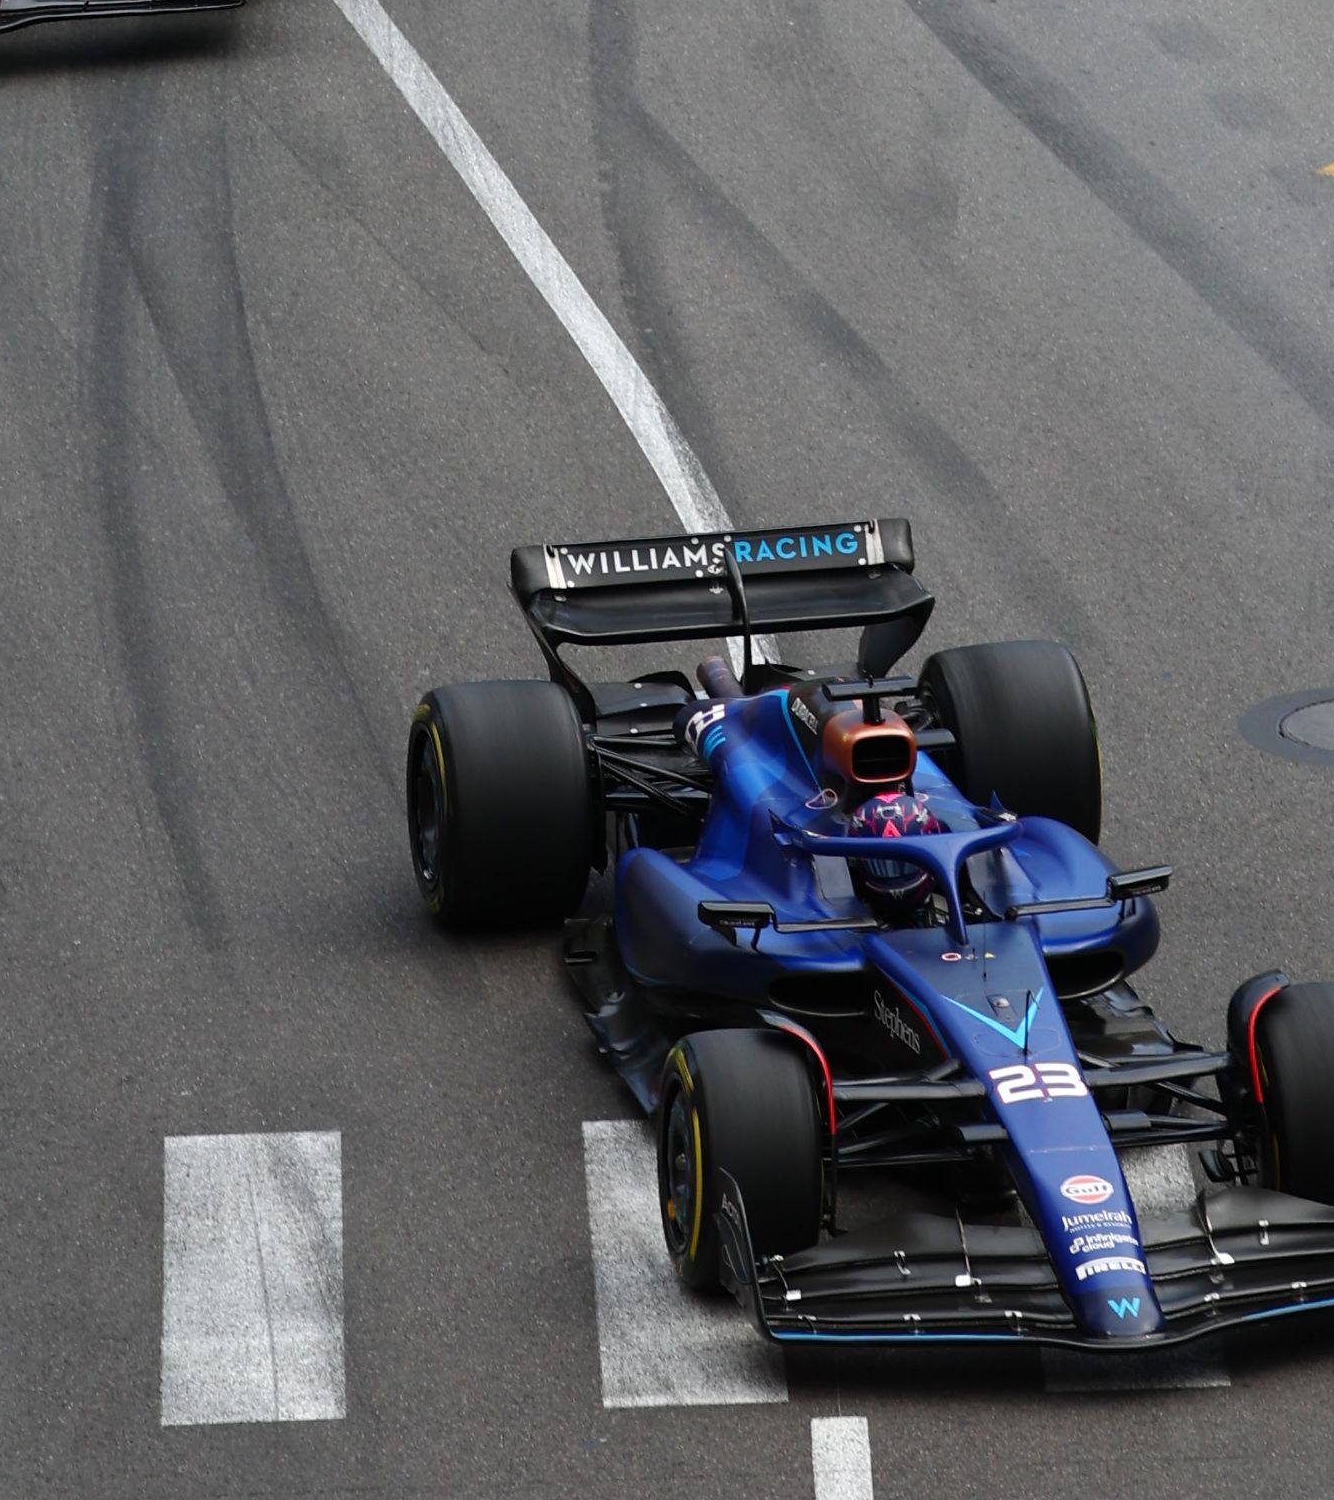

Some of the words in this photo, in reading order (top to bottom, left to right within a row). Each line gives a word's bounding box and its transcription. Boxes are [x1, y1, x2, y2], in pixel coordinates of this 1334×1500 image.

[567, 542, 725, 576] WILLIAMS
[734, 532, 859, 564] RACING
[873, 990, 921, 1054] Stephens
[988, 1062, 1089, 1104] 23
[1066, 1183, 1109, 1195] Gulf
[1061, 1210, 1132, 1232] Jumeirah
[1075, 1256, 1147, 1281] PIRELLI
